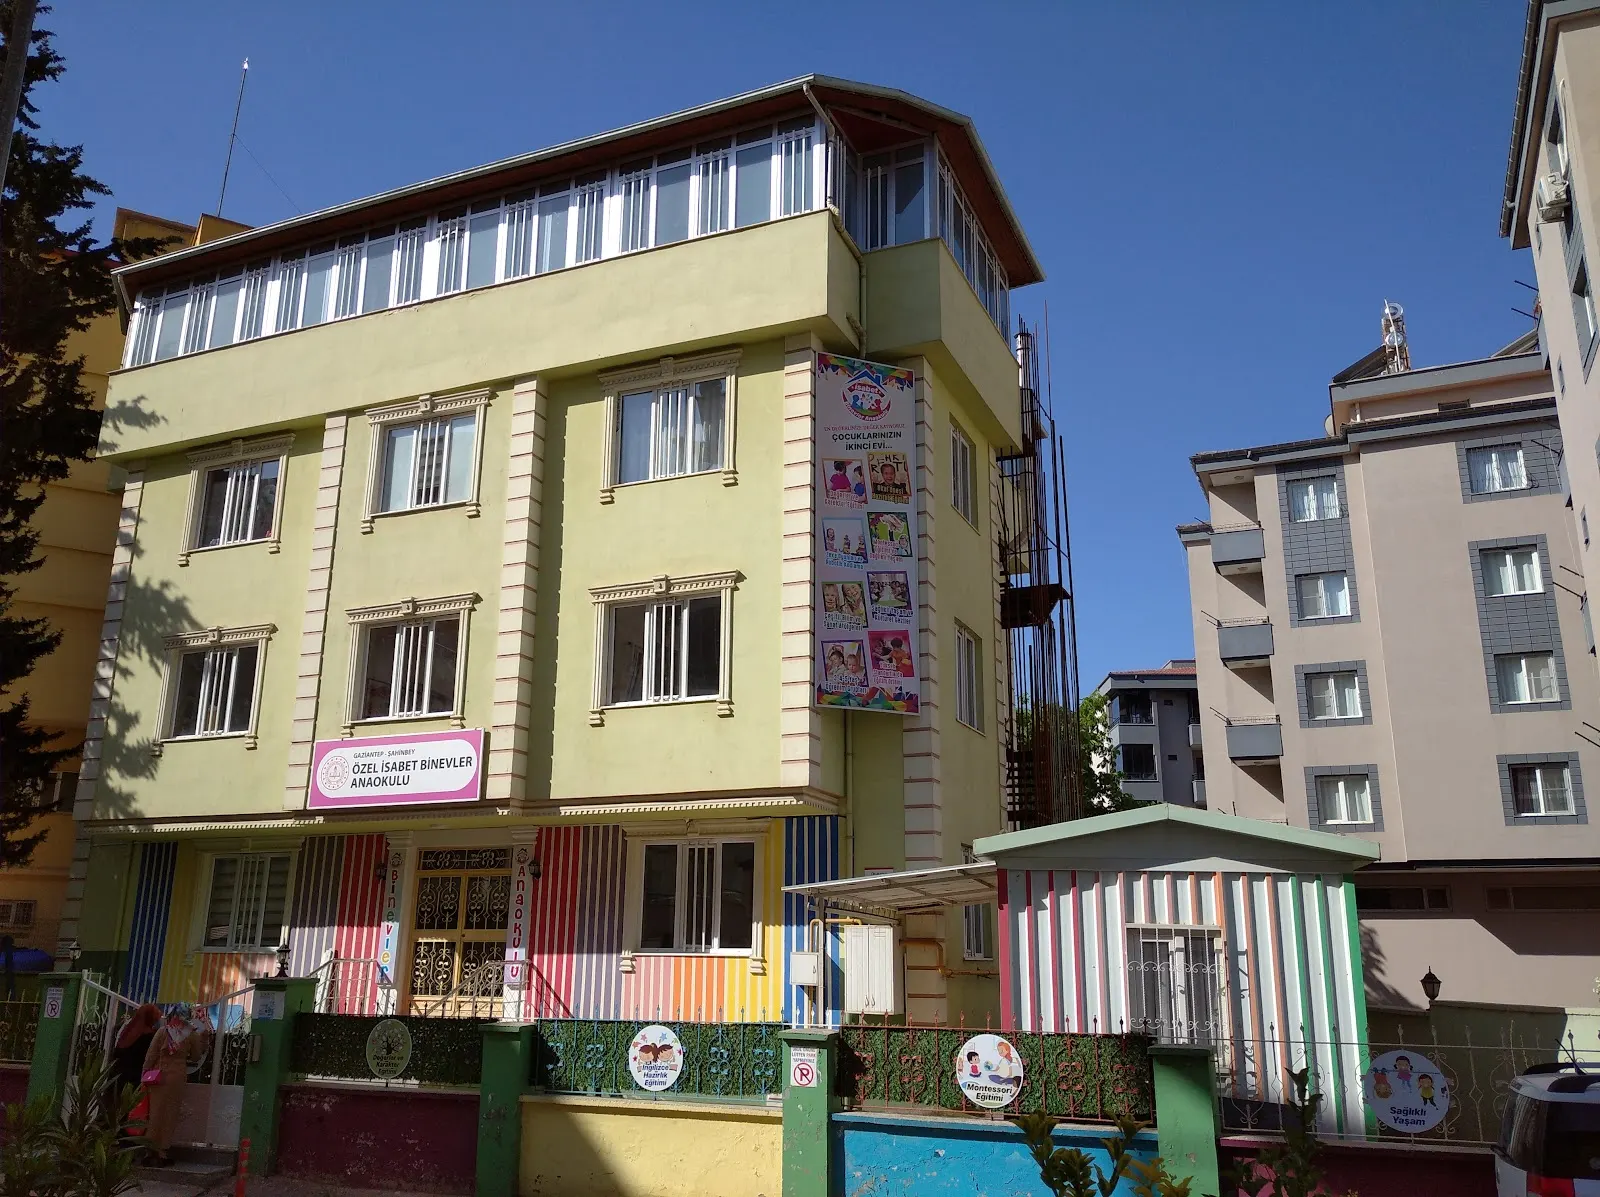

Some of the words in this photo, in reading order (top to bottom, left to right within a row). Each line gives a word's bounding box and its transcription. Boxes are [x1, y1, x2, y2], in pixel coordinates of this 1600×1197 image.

[832, 431, 902, 442] ÇOCUKLARINIZIN
[845, 440, 871, 451] İKİNCİ
[354, 750, 384, 759] GAZİANTEP
[352, 762, 379, 775] ÖZEL
[381, 759, 418, 773] İSABET
[421, 756, 473, 770] BİNEVLER
[350, 775, 410, 789] ANAOKULU
[645, 1079, 667, 1087] Eğitimi
[967, 1083, 1013, 1094] Montessori
[976, 1093, 1004, 1102] Eğitimi
[1390, 1106, 1427, 1117] Sağlıklı
[1393, 1116, 1426, 1126] Yaşam
